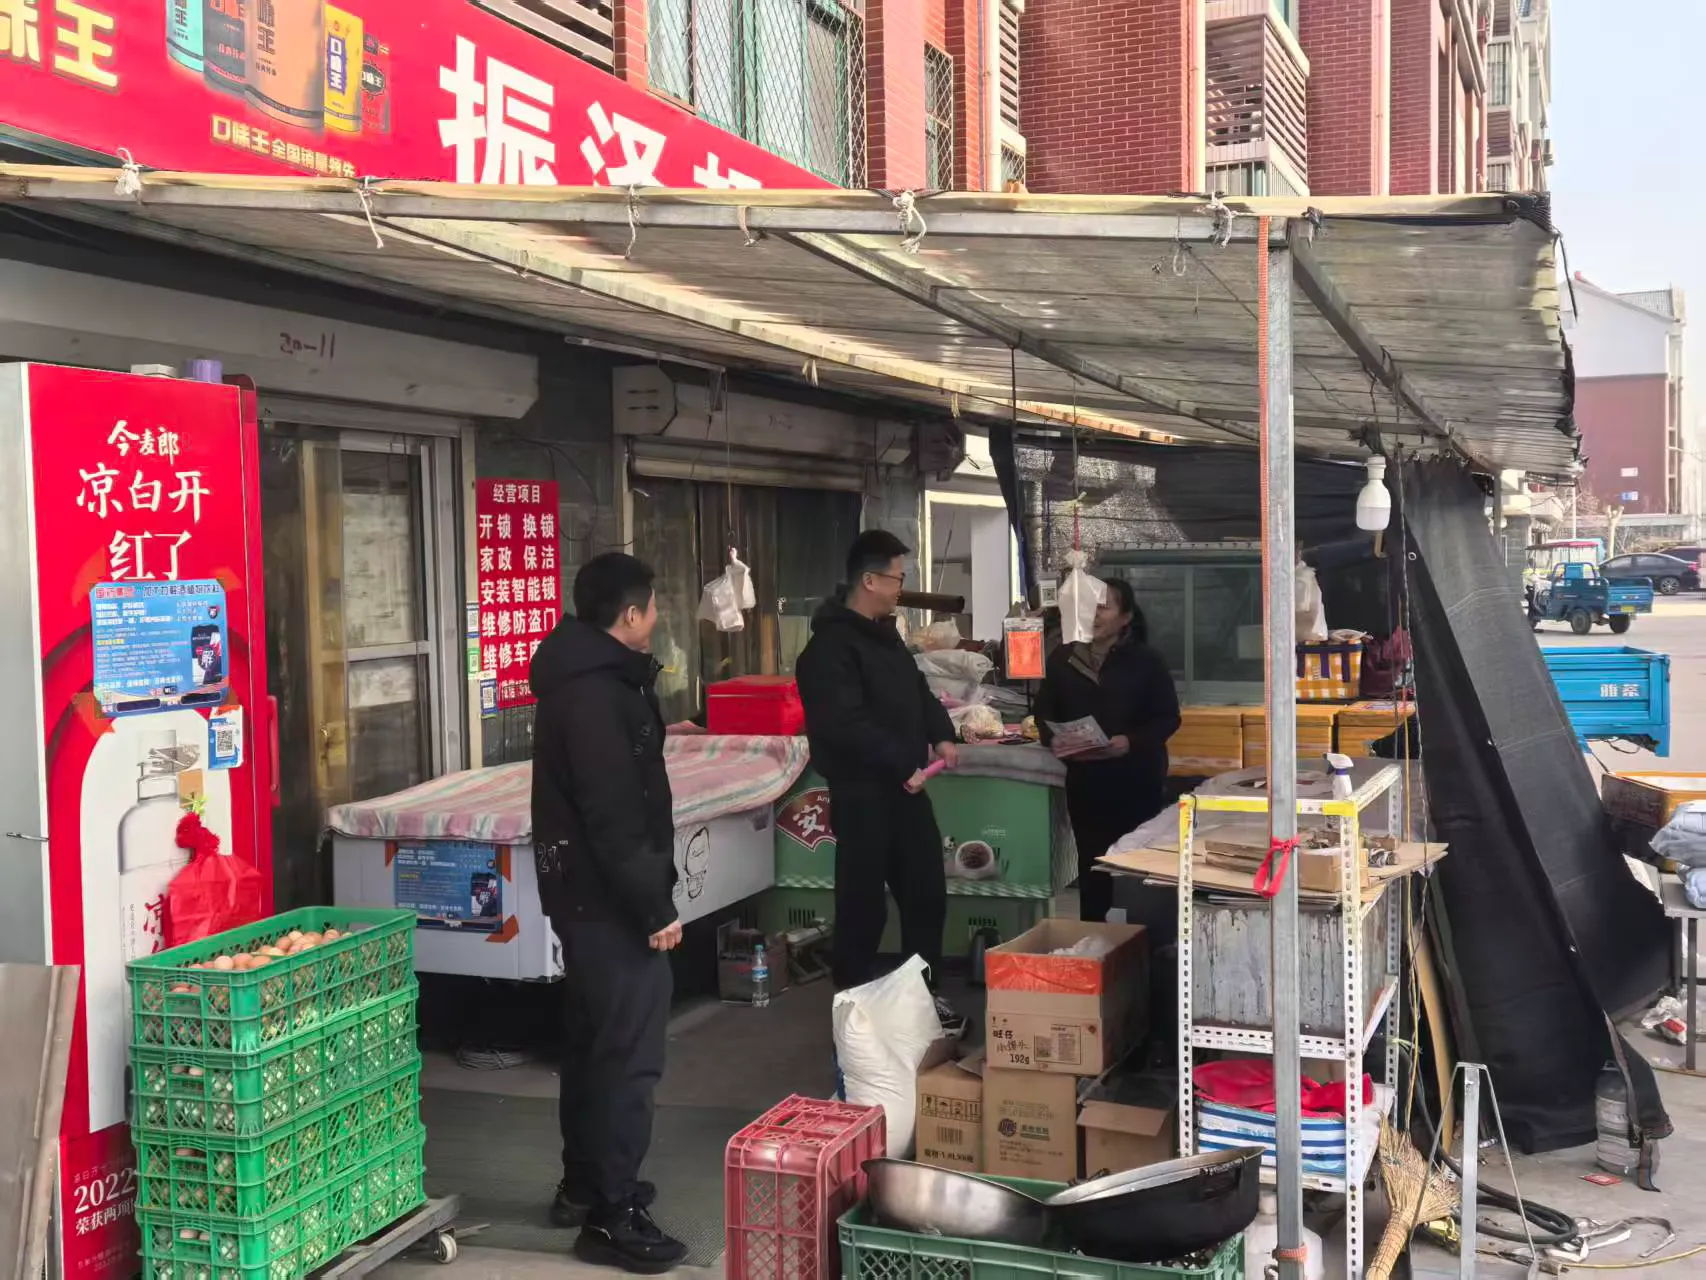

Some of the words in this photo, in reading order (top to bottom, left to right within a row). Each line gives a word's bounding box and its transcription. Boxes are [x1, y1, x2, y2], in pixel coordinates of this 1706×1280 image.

[212, 114, 270, 155] 口味王
[107, 419, 181, 465] 今麦郎
[76, 462, 210, 524] 凉白开
[493, 484, 541, 504] 经营项目
[480, 514, 512, 539] 开锁
[523, 513, 555, 539] 换锁
[109, 530, 192, 581] 红了
[481, 545, 512, 573] 家政
[523, 544, 555, 571] 保洁
[481, 577, 556, 606] 安装智能锁
[482, 608, 556, 638] 维修防盗门
[792, 804, 832, 838] 安
[1010, 1053, 1031, 1065] 192g
[73, 1167, 136, 1214] 2022
